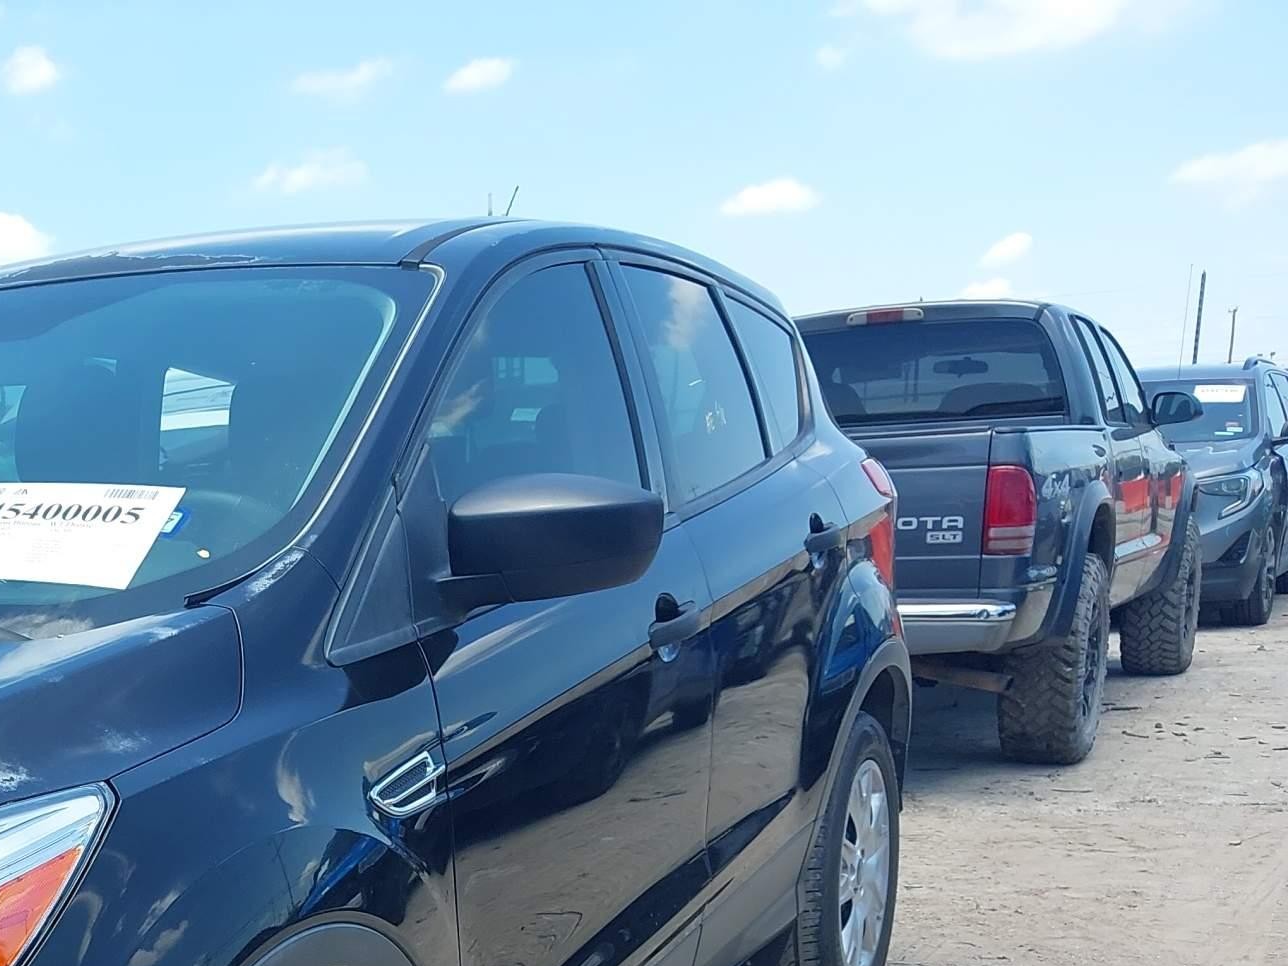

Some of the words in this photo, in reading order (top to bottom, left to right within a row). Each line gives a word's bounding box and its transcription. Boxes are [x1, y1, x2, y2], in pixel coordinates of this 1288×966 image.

[1042, 473, 1071, 498] 4x4
[896, 516, 964, 530] OTA
[928, 532, 962, 542] SLT
